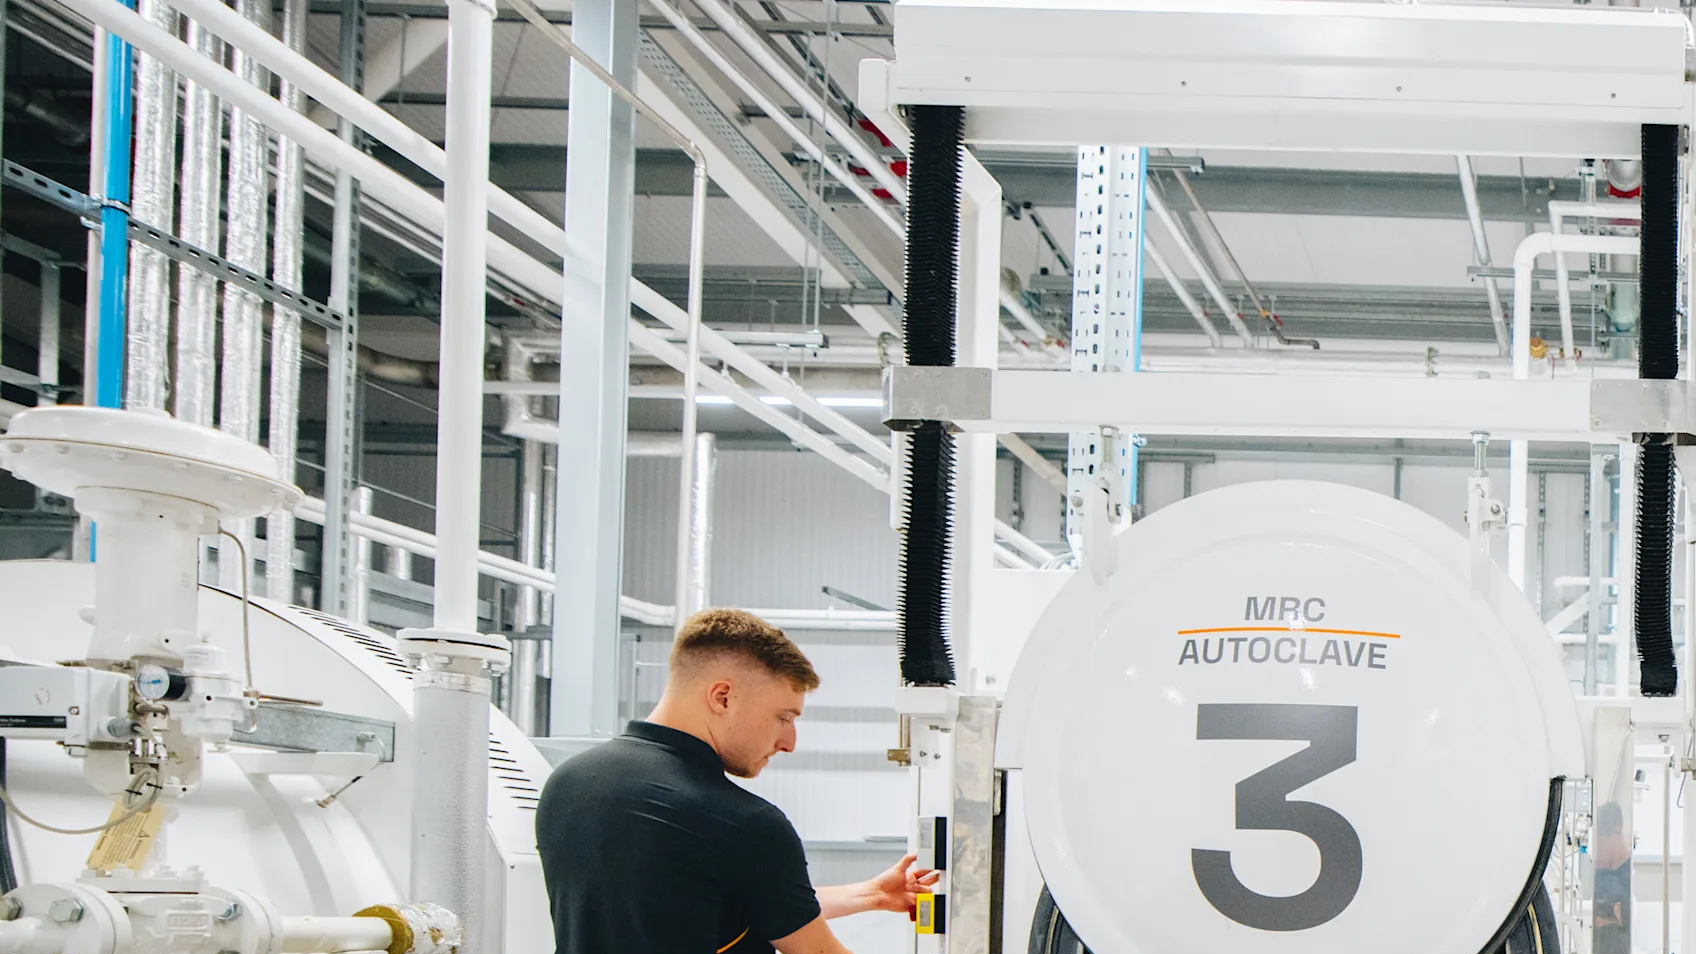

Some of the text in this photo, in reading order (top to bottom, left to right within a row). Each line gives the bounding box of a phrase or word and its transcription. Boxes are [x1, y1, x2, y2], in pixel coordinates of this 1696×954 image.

[1244, 596, 1326, 622] MRC
[1178, 637, 1388, 669] AUTOCLAVE
[1191, 703, 1363, 932] 3
